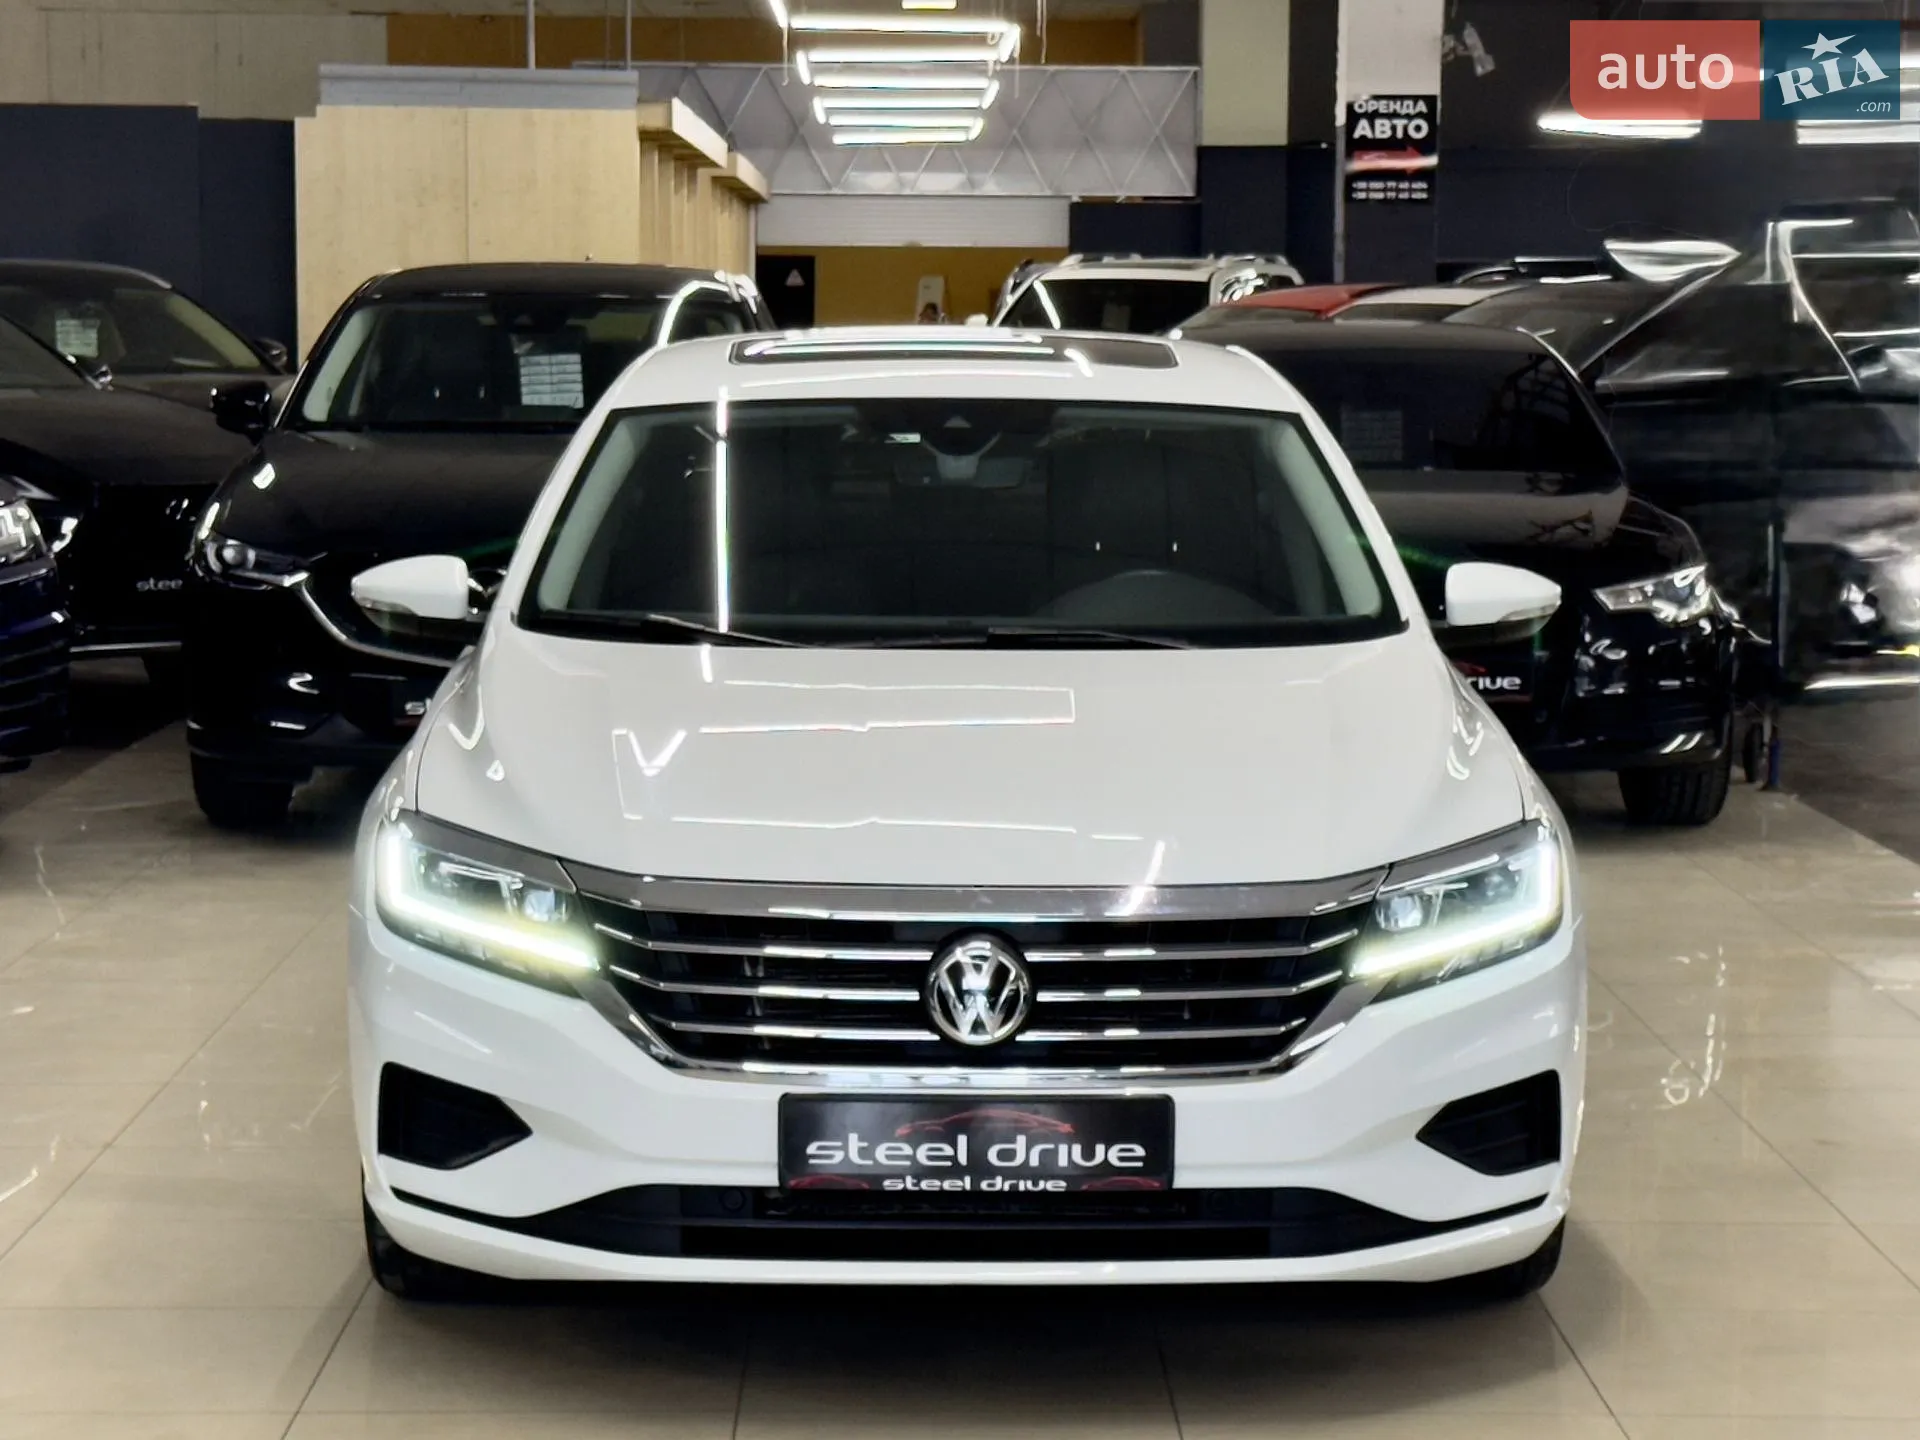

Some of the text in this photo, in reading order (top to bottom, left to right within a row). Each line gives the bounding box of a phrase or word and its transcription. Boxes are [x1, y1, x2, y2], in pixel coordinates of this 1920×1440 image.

[1353, 100, 1428, 116] ОРЕНДА
[1353, 118, 1429, 140] АВТО
[806, 1133, 1146, 1167] steel drive
[883, 1175, 1067, 1192] steel drive
